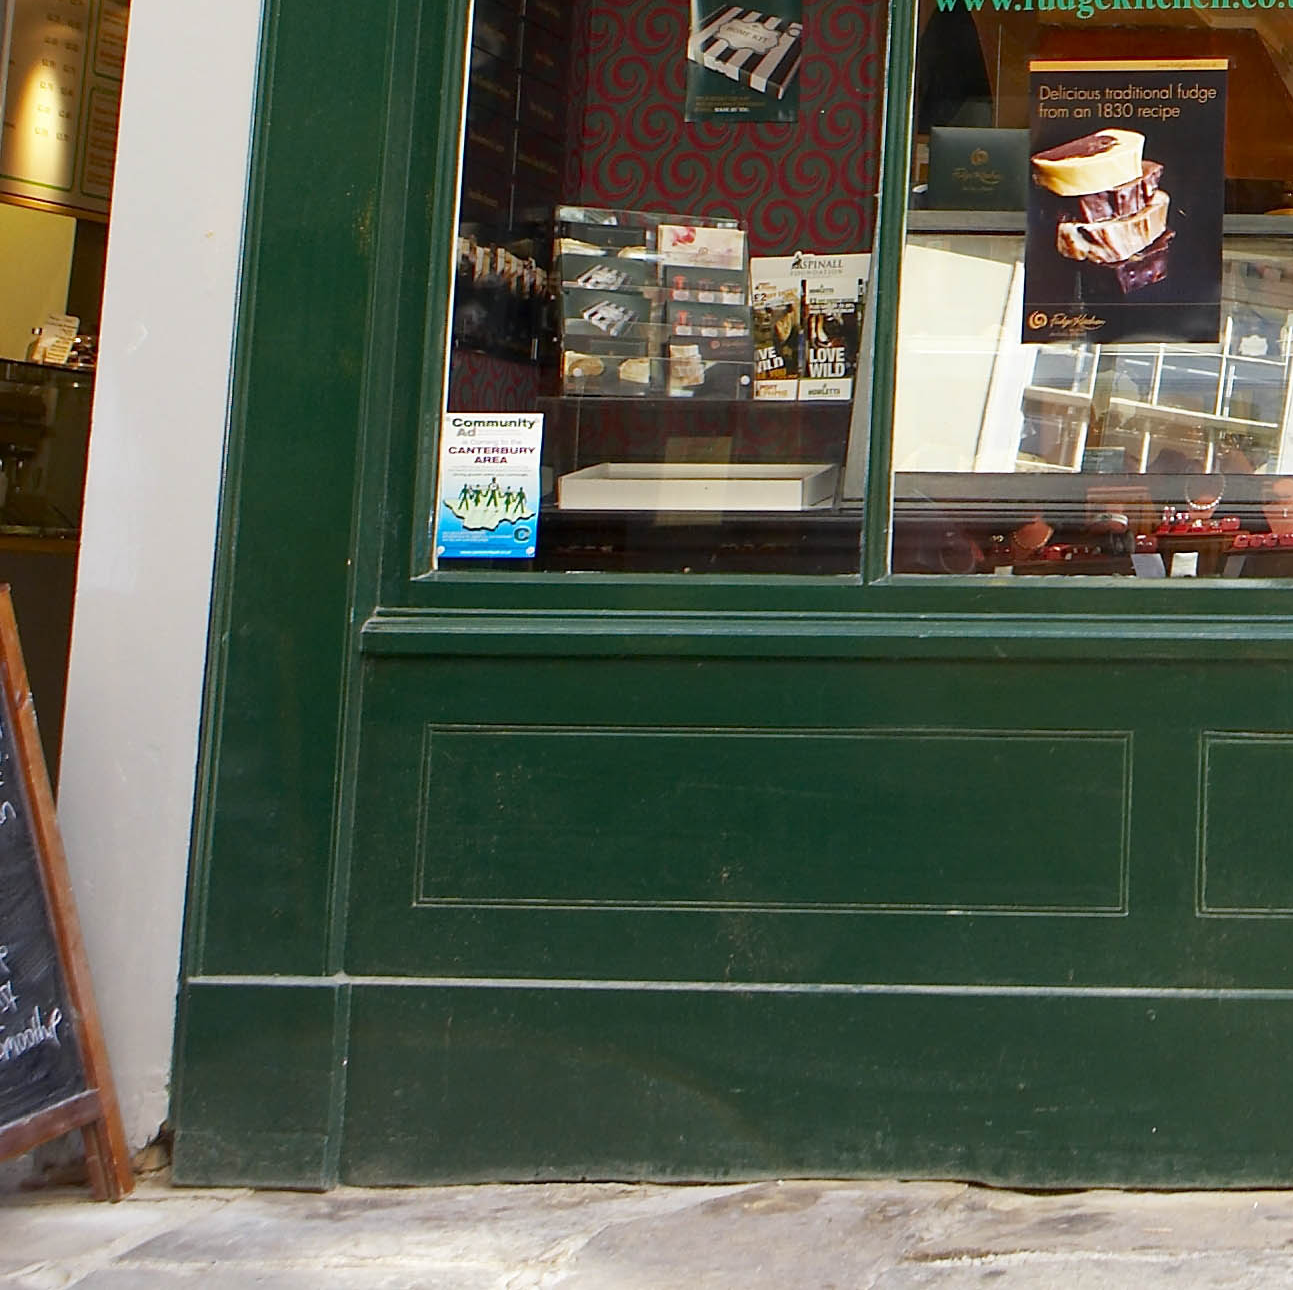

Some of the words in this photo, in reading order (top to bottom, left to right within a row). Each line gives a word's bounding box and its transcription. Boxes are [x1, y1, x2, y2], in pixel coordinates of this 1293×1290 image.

[1039, 84, 1101, 101] Delicious
[1105, 83, 1173, 100] traditional
[1177, 82, 1217, 103] fudge
[1038, 102, 1069, 118] from
[1073, 106, 1092, 118] an
[1097, 102, 1134, 118] 1830
[1137, 104, 1181, 121] recipe
[808, 347, 847, 363] LOVE
[808, 363, 847, 379] WILD
[452, 417, 536, 430] Community
[456, 427, 477, 437] Ad
[448, 446, 537, 455] CANTERBURY
[473, 456, 508, 464] AREA
